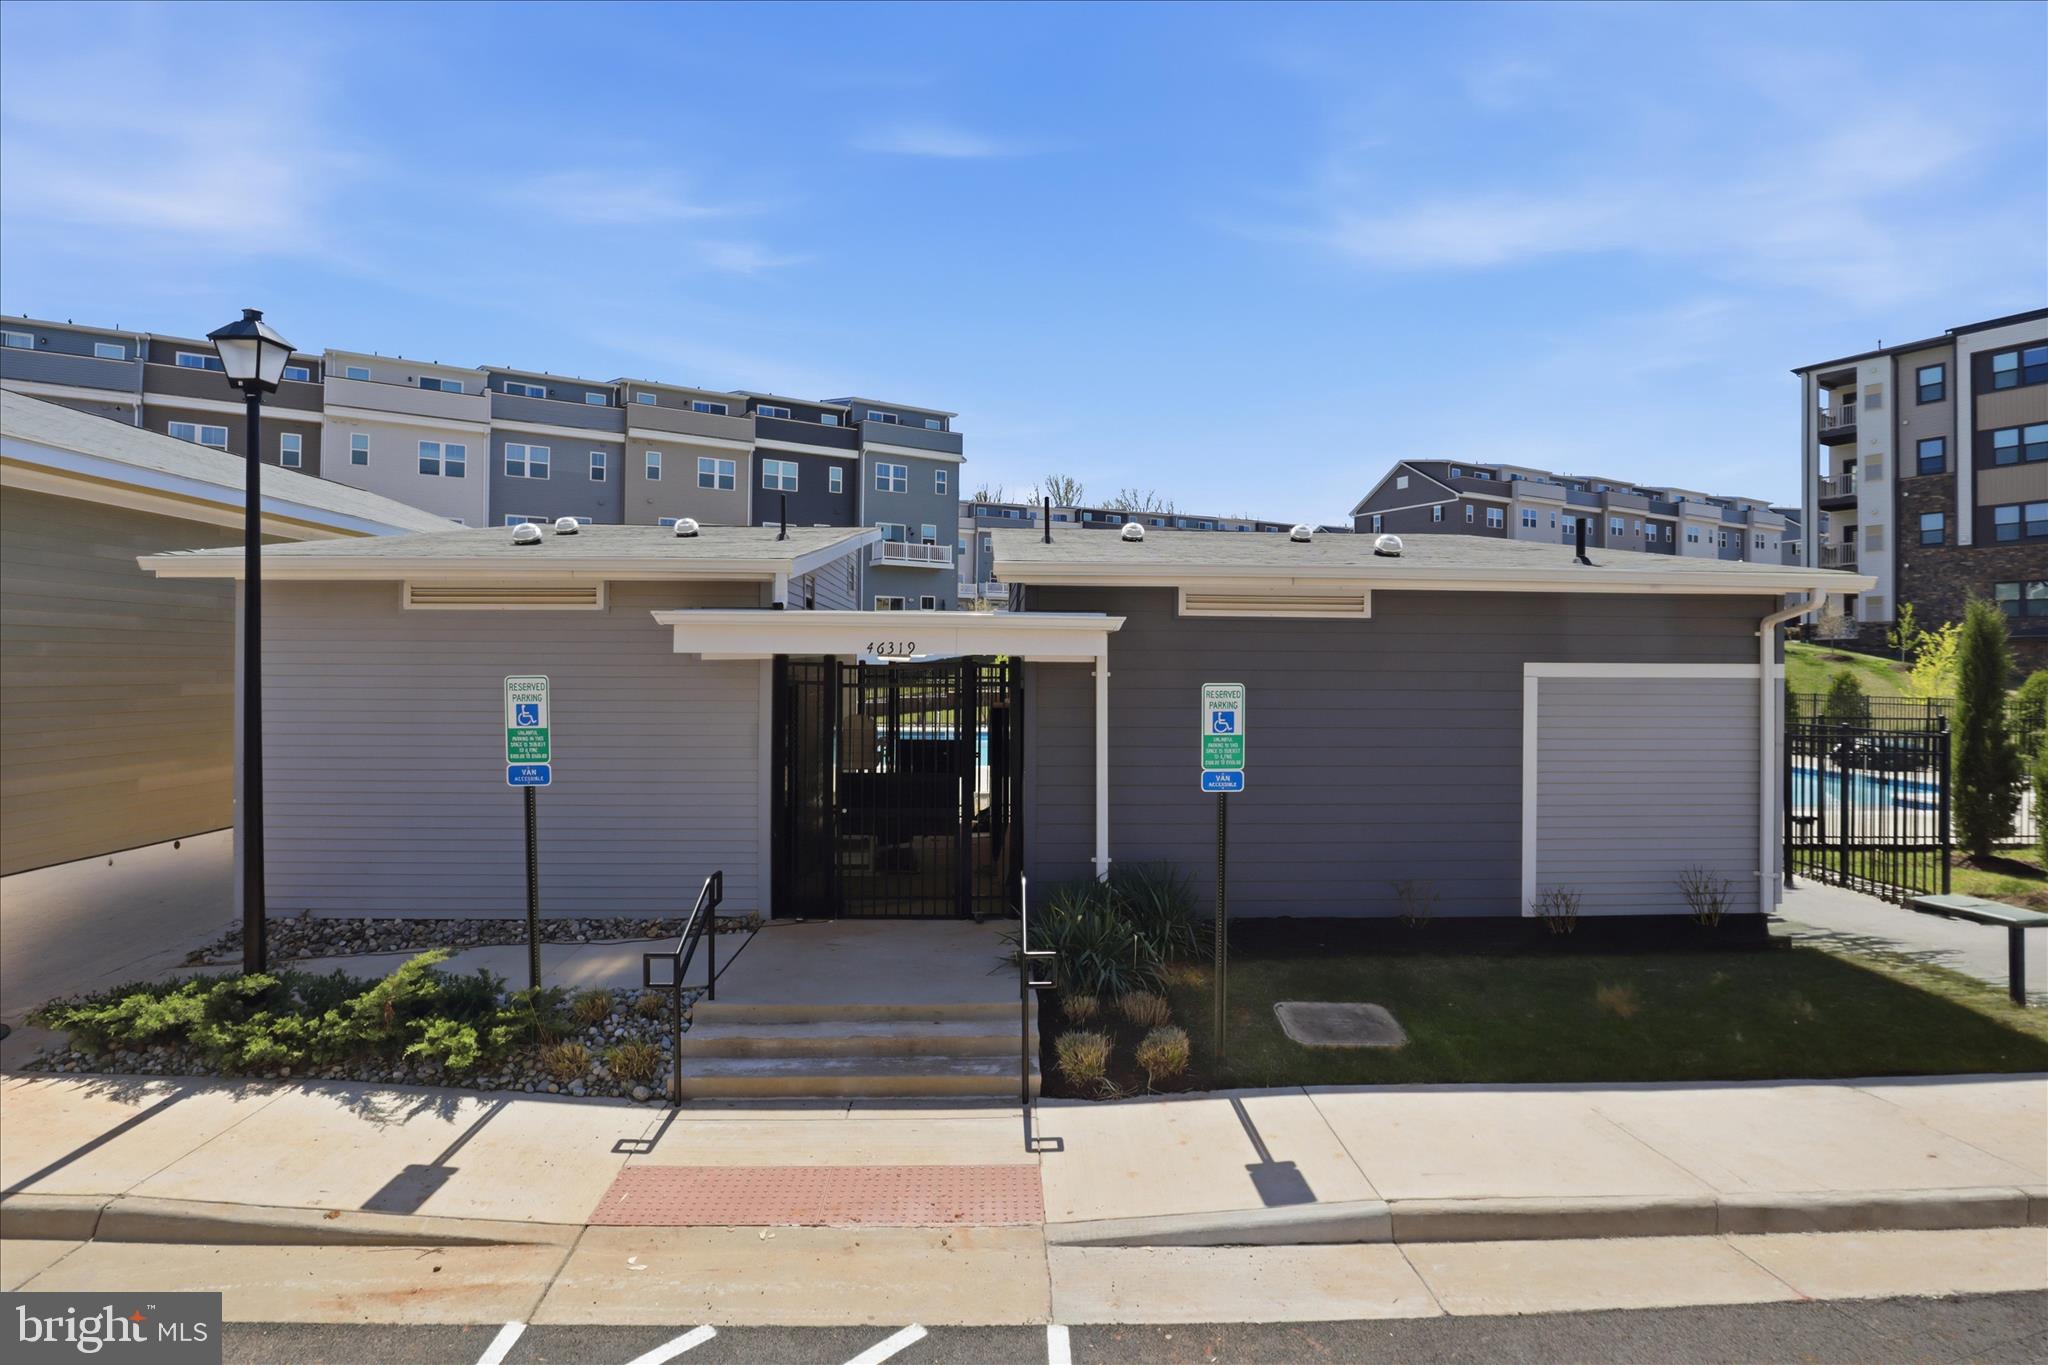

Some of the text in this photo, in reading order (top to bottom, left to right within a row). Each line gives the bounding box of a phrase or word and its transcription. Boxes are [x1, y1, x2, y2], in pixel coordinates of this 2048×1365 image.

[867, 641, 915, 655] 46319
[508, 682, 546, 691] RESERVED
[512, 693, 543, 702] PARKING
[1205, 690, 1242, 699] RESERVED
[1208, 701, 1239, 710] PARKING
